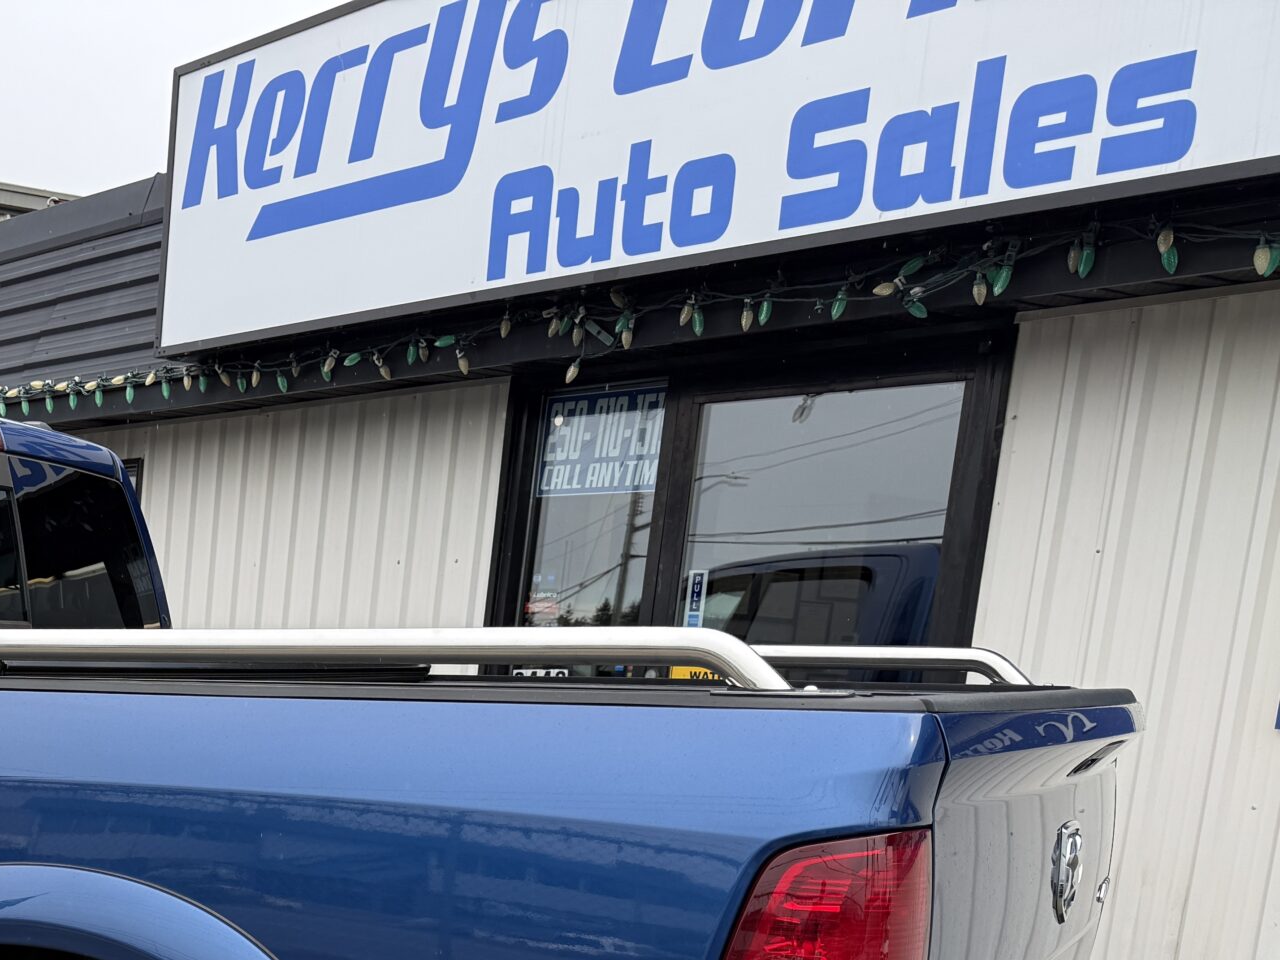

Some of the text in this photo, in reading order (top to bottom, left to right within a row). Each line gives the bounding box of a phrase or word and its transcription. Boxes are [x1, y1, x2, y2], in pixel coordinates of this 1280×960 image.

[182, 0, 567, 241] Kerrys
[486, 50, 1197, 282] Auto Sales
[540, 459, 659, 490] CALL ANYTIM
[692, 575, 701, 609] PULL
